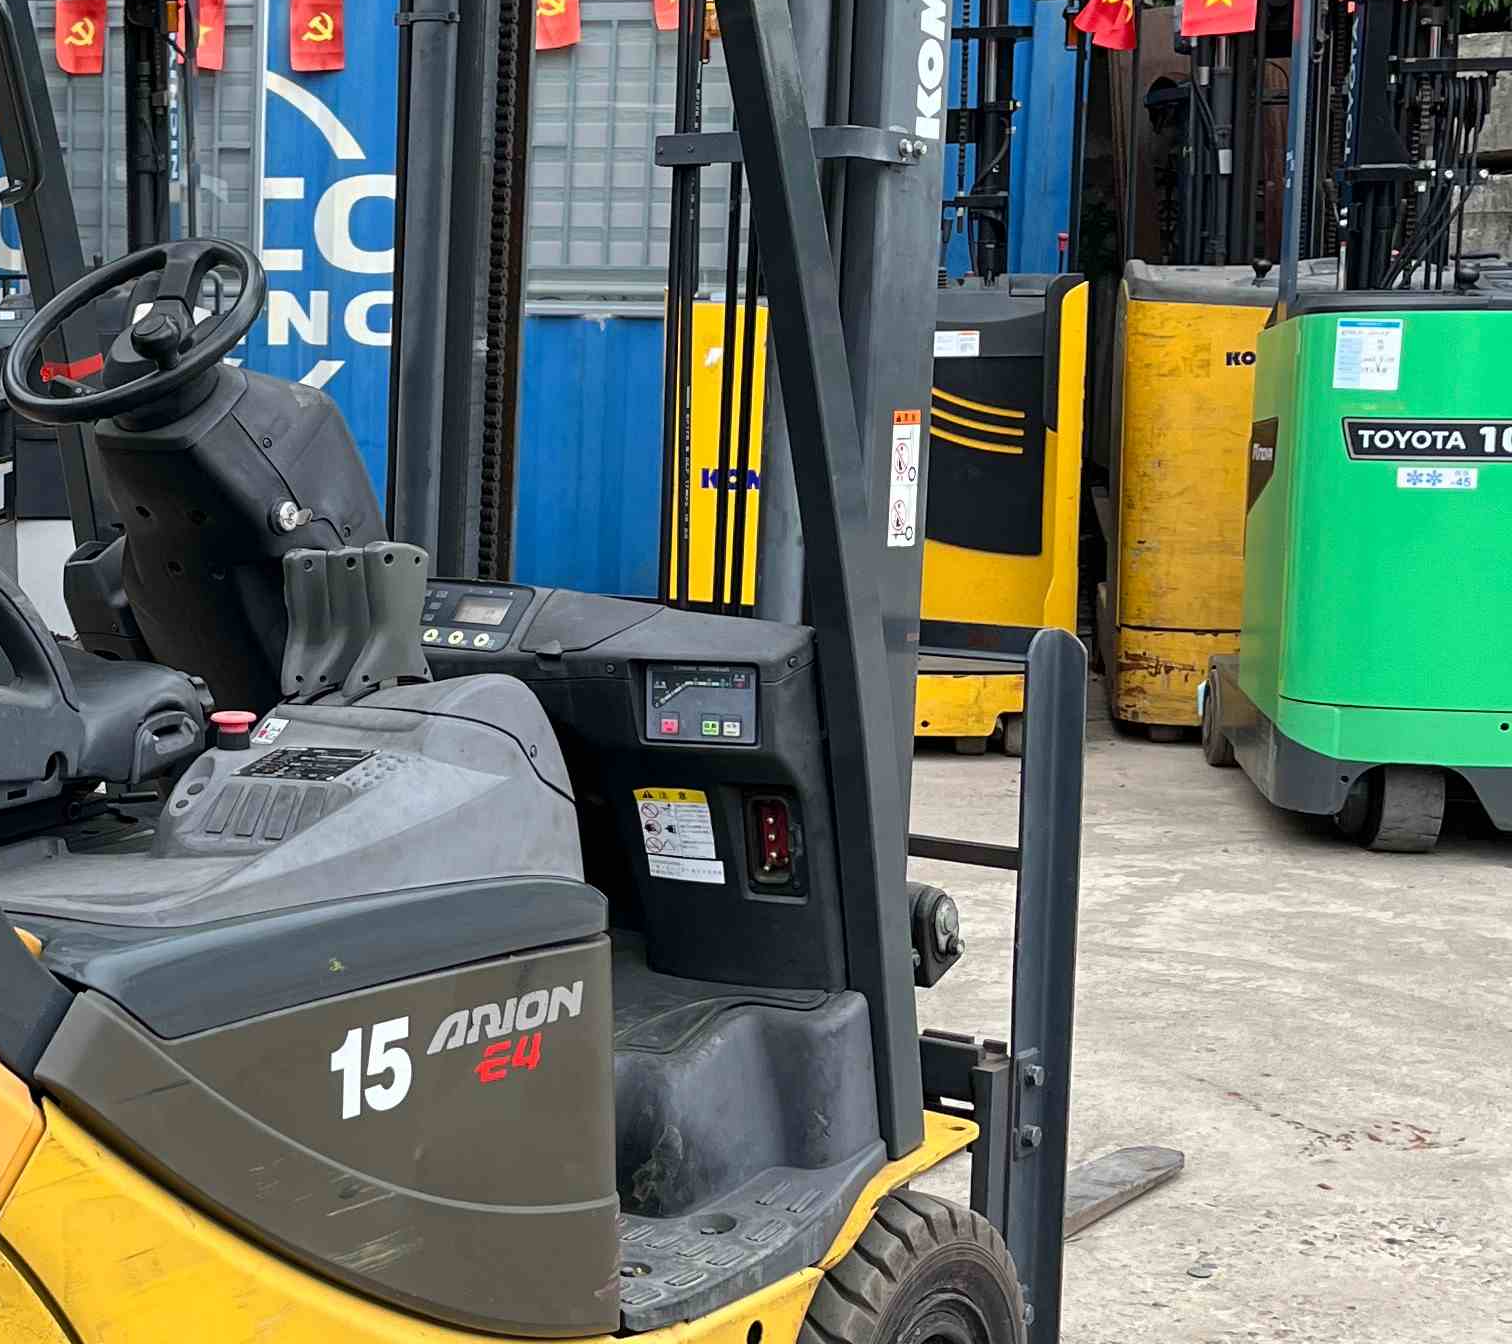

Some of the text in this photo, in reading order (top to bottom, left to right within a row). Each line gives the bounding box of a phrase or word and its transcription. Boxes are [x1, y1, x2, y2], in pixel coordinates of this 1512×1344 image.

[1358, 429, 1467, 450] TOYOTA
[330, 980, 584, 1119] 15 ARION
[473, 1031, 543, 1086] E4
